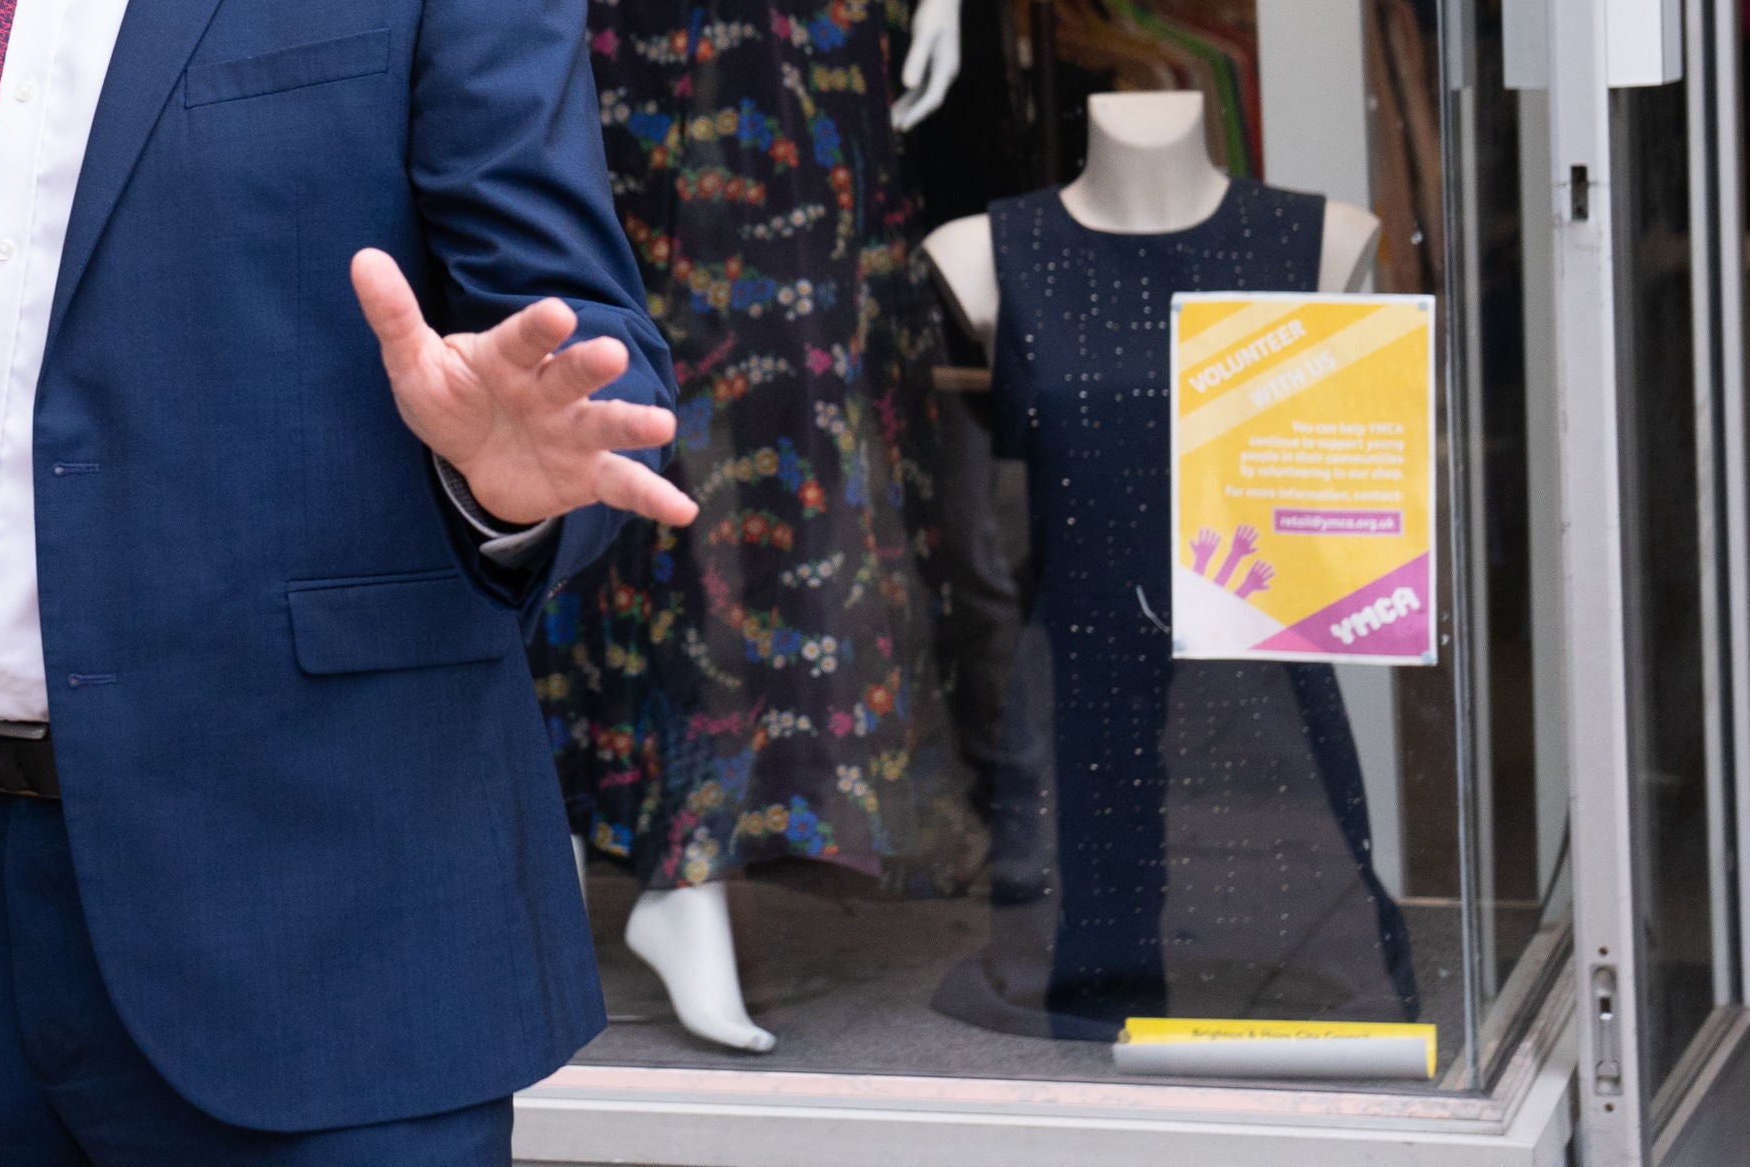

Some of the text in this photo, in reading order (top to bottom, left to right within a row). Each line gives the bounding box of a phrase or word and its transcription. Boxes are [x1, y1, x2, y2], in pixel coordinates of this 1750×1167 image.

[1188, 319, 1308, 393] VOLUNTEER
[1248, 350, 1338, 410] WITH US
[1292, 421, 1404, 436] You can help YMCA
[1248, 436, 1404, 452] continue to support young
[1240, 451, 1404, 464] people in their communities
[1240, 465, 1254, 478] by
[1256, 466, 1331, 481] volunteering
[1333, 467, 1345, 479] in
[1347, 469, 1369, 479] our
[1225, 485, 1243, 497] For
[1245, 487, 1275, 498] more
[1280, 516, 1395, 532] retail@ymca.org.uk
[1330, 587, 1420, 644] YMCA
